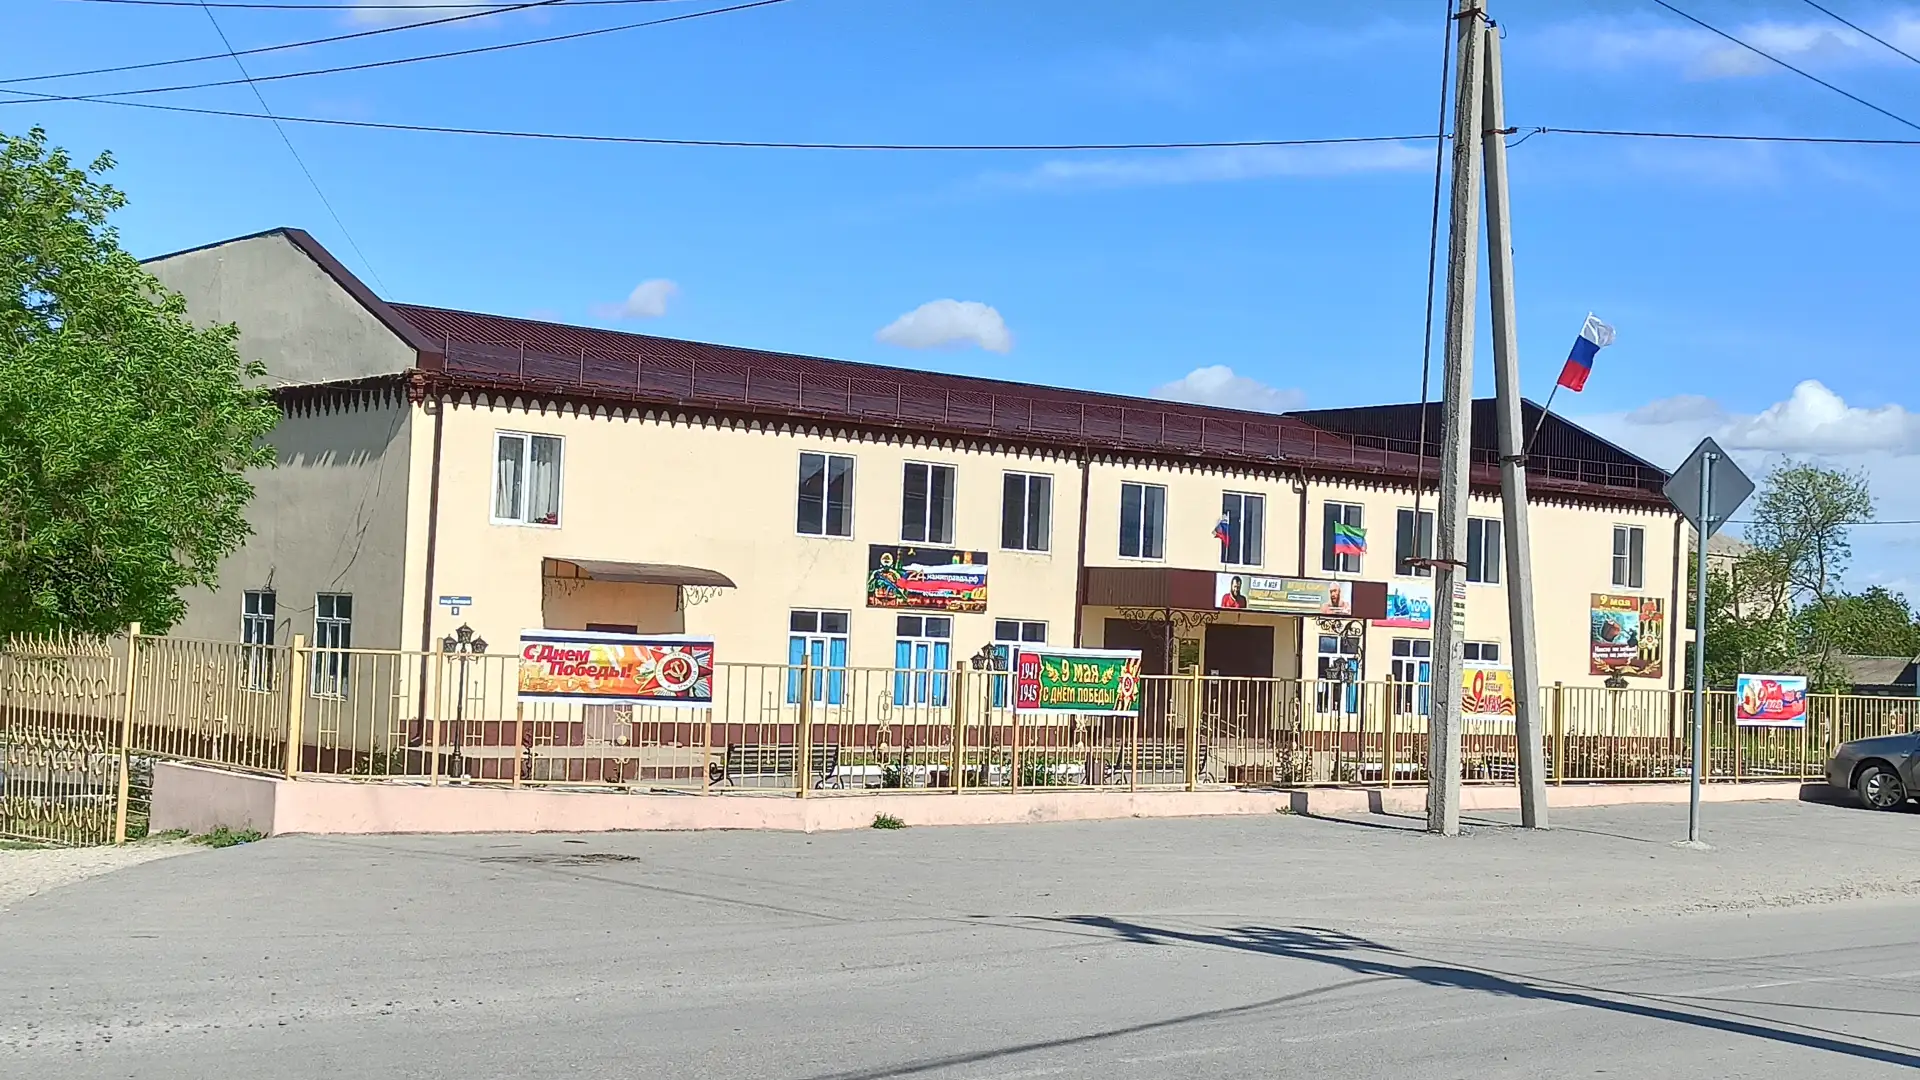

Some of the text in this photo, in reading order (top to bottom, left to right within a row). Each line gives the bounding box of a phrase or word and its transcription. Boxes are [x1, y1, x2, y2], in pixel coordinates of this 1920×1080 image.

[1410, 598, 1429, 613] 100
[1600, 595, 1608, 605] 9
[523, 644, 591, 663] С Днем
[549, 661, 633, 680] Победы!
[1021, 663, 1038, 680] 1941
[1061, 659, 1099, 683] 9 мая
[1020, 684, 1038, 701] 1945
[1043, 687, 1049, 702] С
[1472, 670, 1484, 712] 9
